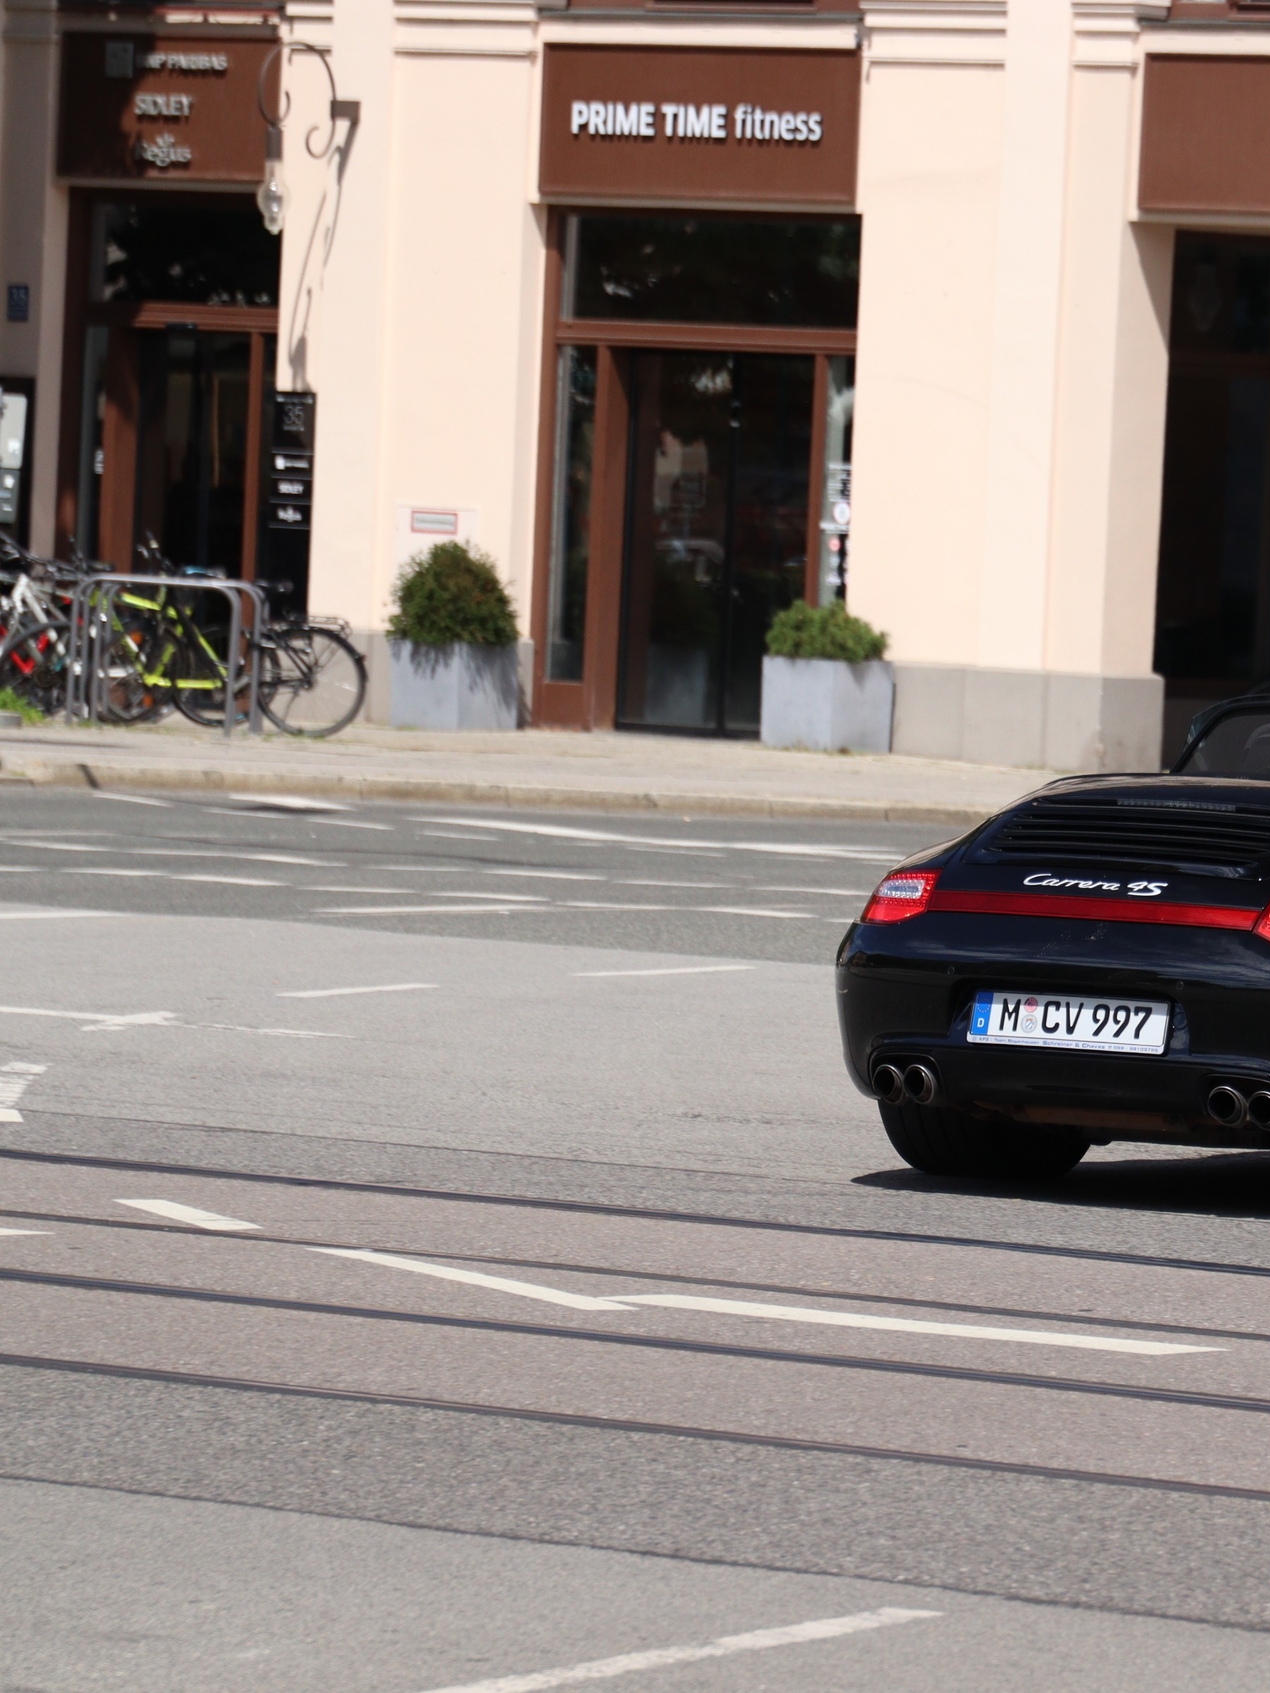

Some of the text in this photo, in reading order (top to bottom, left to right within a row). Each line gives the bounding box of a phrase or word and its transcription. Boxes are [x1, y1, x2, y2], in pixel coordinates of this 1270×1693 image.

[570, 100, 823, 142] PRIME TIME fitness
[283, 405, 304, 425] 35
[1023, 873, 1169, 896] Carrera 4S
[977, 1017, 985, 1028] D
[999, 998, 1153, 1040] M CV 997
